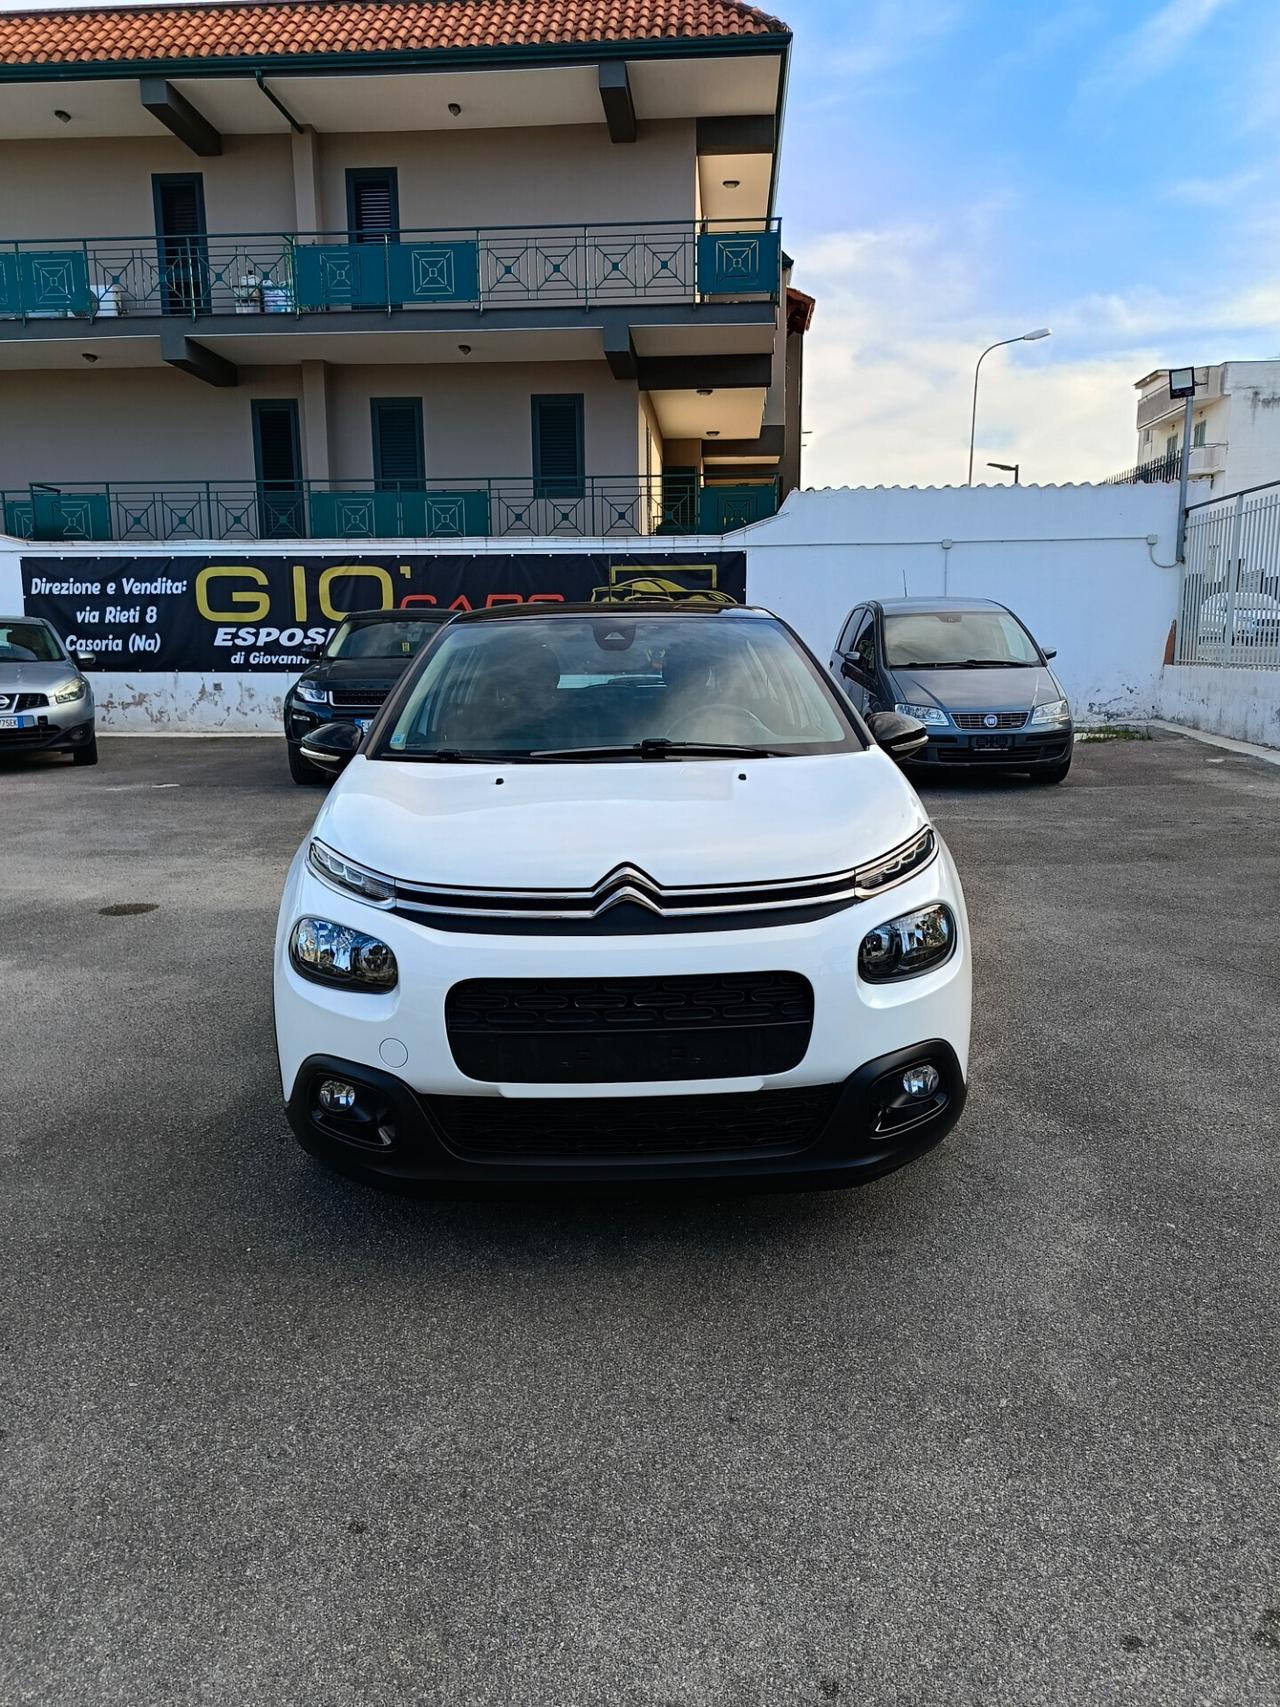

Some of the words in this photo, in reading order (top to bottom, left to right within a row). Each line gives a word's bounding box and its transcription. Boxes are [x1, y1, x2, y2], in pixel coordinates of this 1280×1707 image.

[31, 578, 100, 595] Direzione
[106, 582, 116, 594] e
[121, 577, 188, 595] Vendita:
[76, 606, 99, 623] via
[105, 606, 140, 623] Rieti
[145, 606, 157, 623] 8
[65, 635, 122, 651] Casoria
[128, 633, 161, 653] (Na)
[230, 652, 245, 664] di
